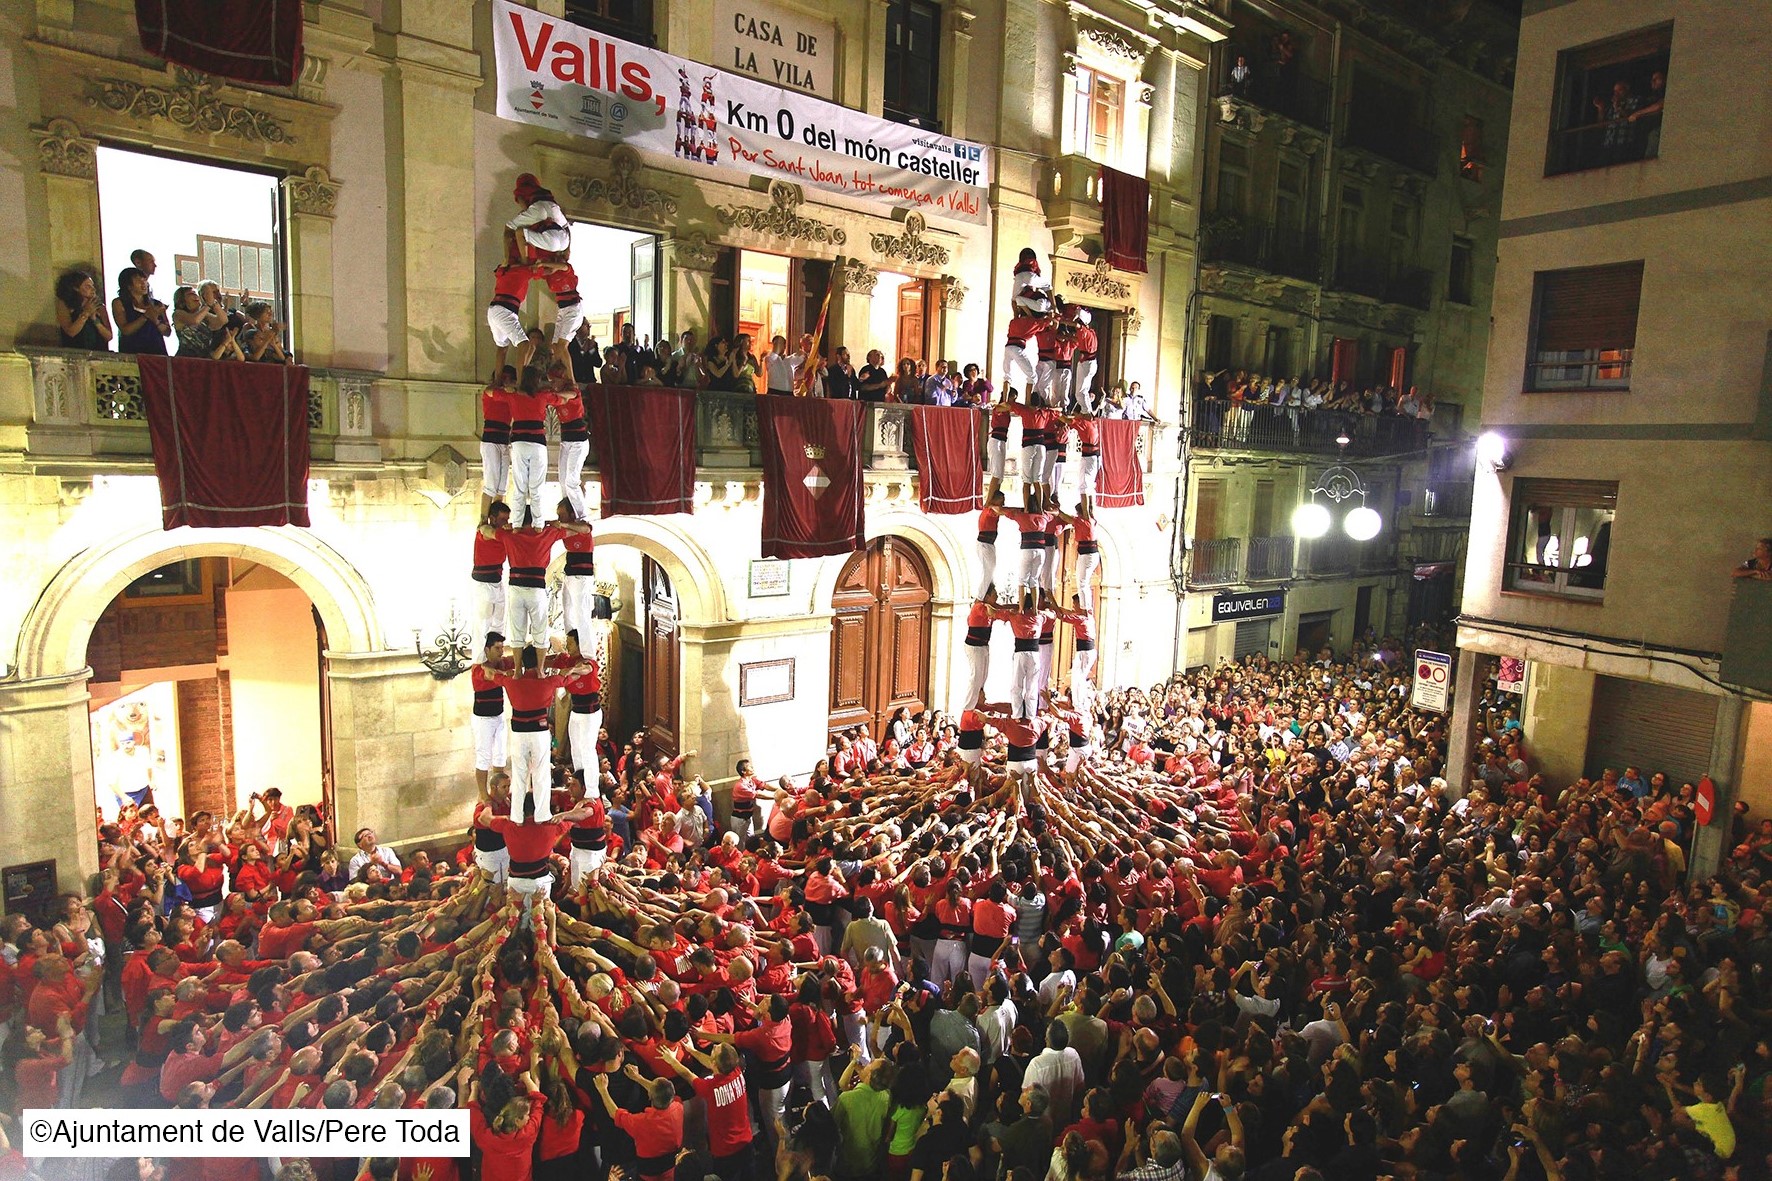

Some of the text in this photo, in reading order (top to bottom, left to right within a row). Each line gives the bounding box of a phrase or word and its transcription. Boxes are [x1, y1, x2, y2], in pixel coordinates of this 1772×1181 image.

[508, 11, 667, 116] Valls,
[734, 13, 817, 57] CASA DE
[734, 46, 816, 91] LA VILA
[727, 100, 980, 186] Km 0 del món casteller
[728, 136, 980, 216] Per Sant Joan, tot comença a Valls!
